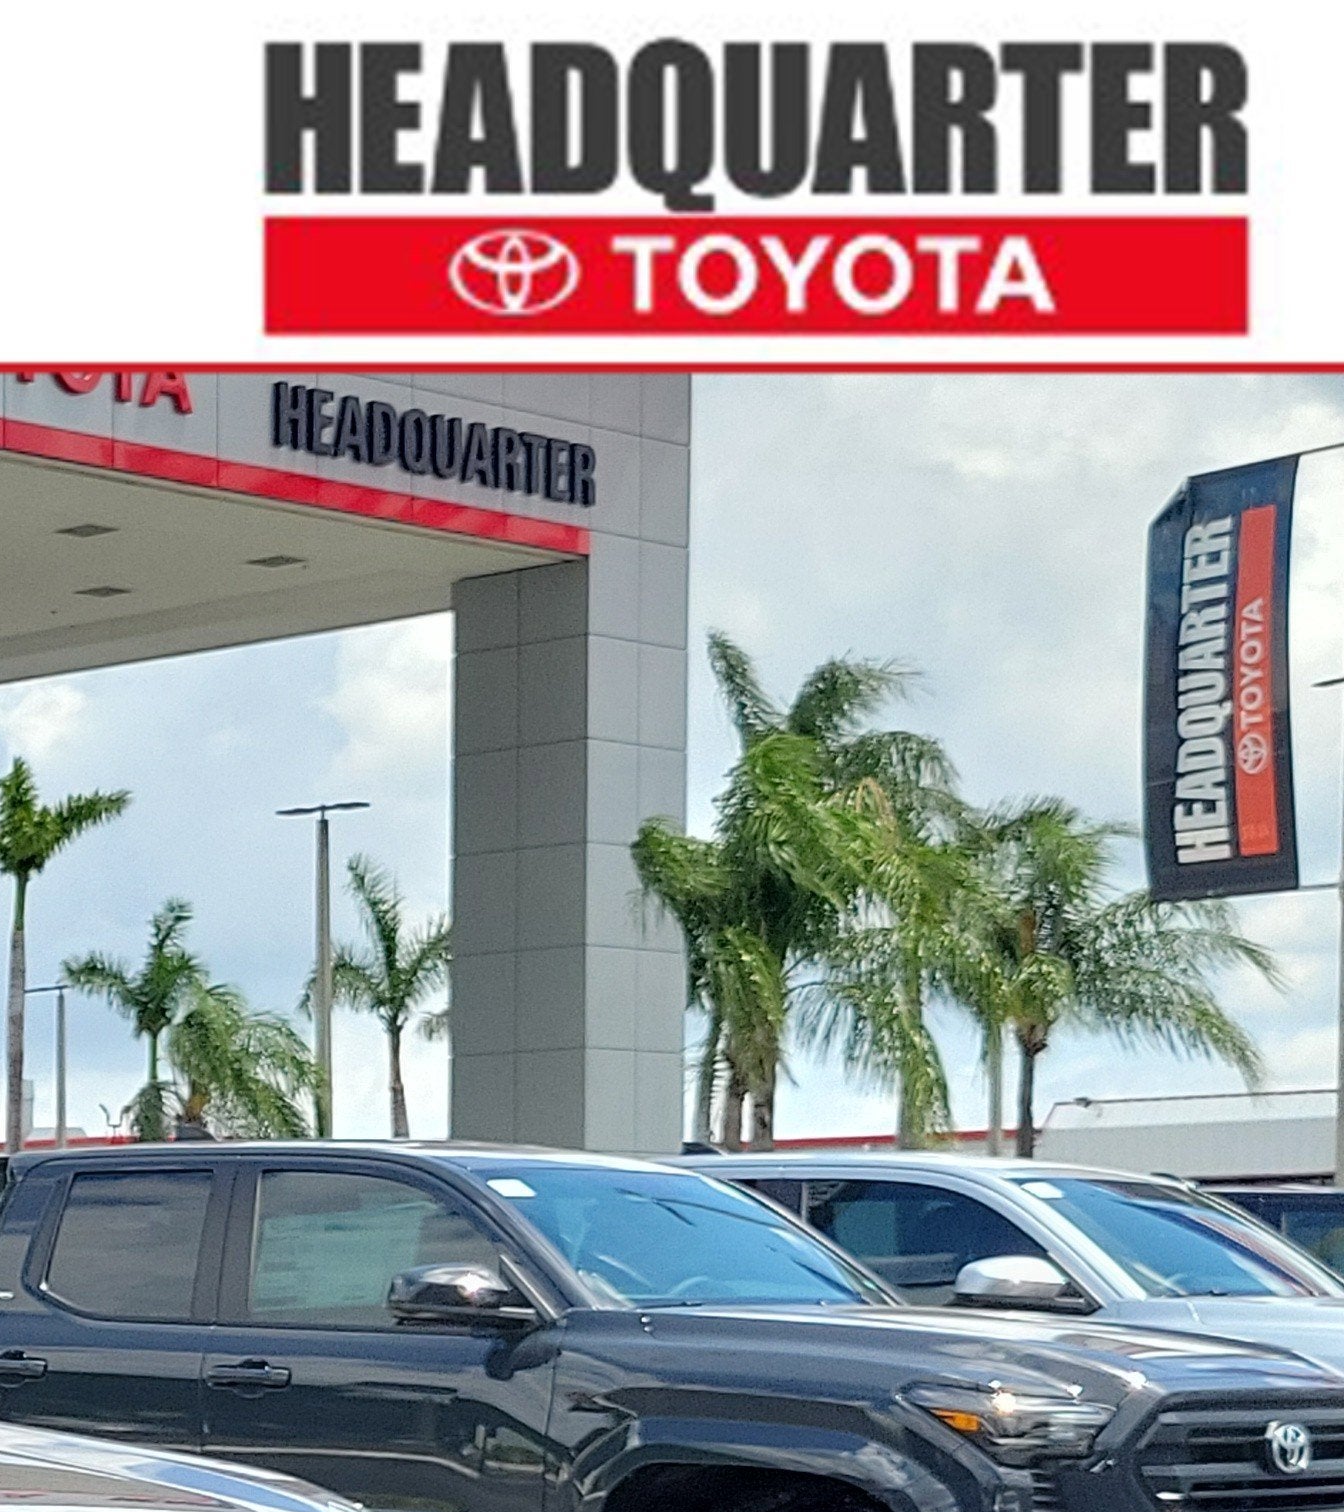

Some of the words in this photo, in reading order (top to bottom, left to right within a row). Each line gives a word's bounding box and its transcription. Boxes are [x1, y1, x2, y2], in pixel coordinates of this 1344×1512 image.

[272, 380, 596, 508] HEADQUARTER
[1173, 515, 1234, 863] HEADQUARTER
[1239, 596, 1263, 730] TOYOTA
